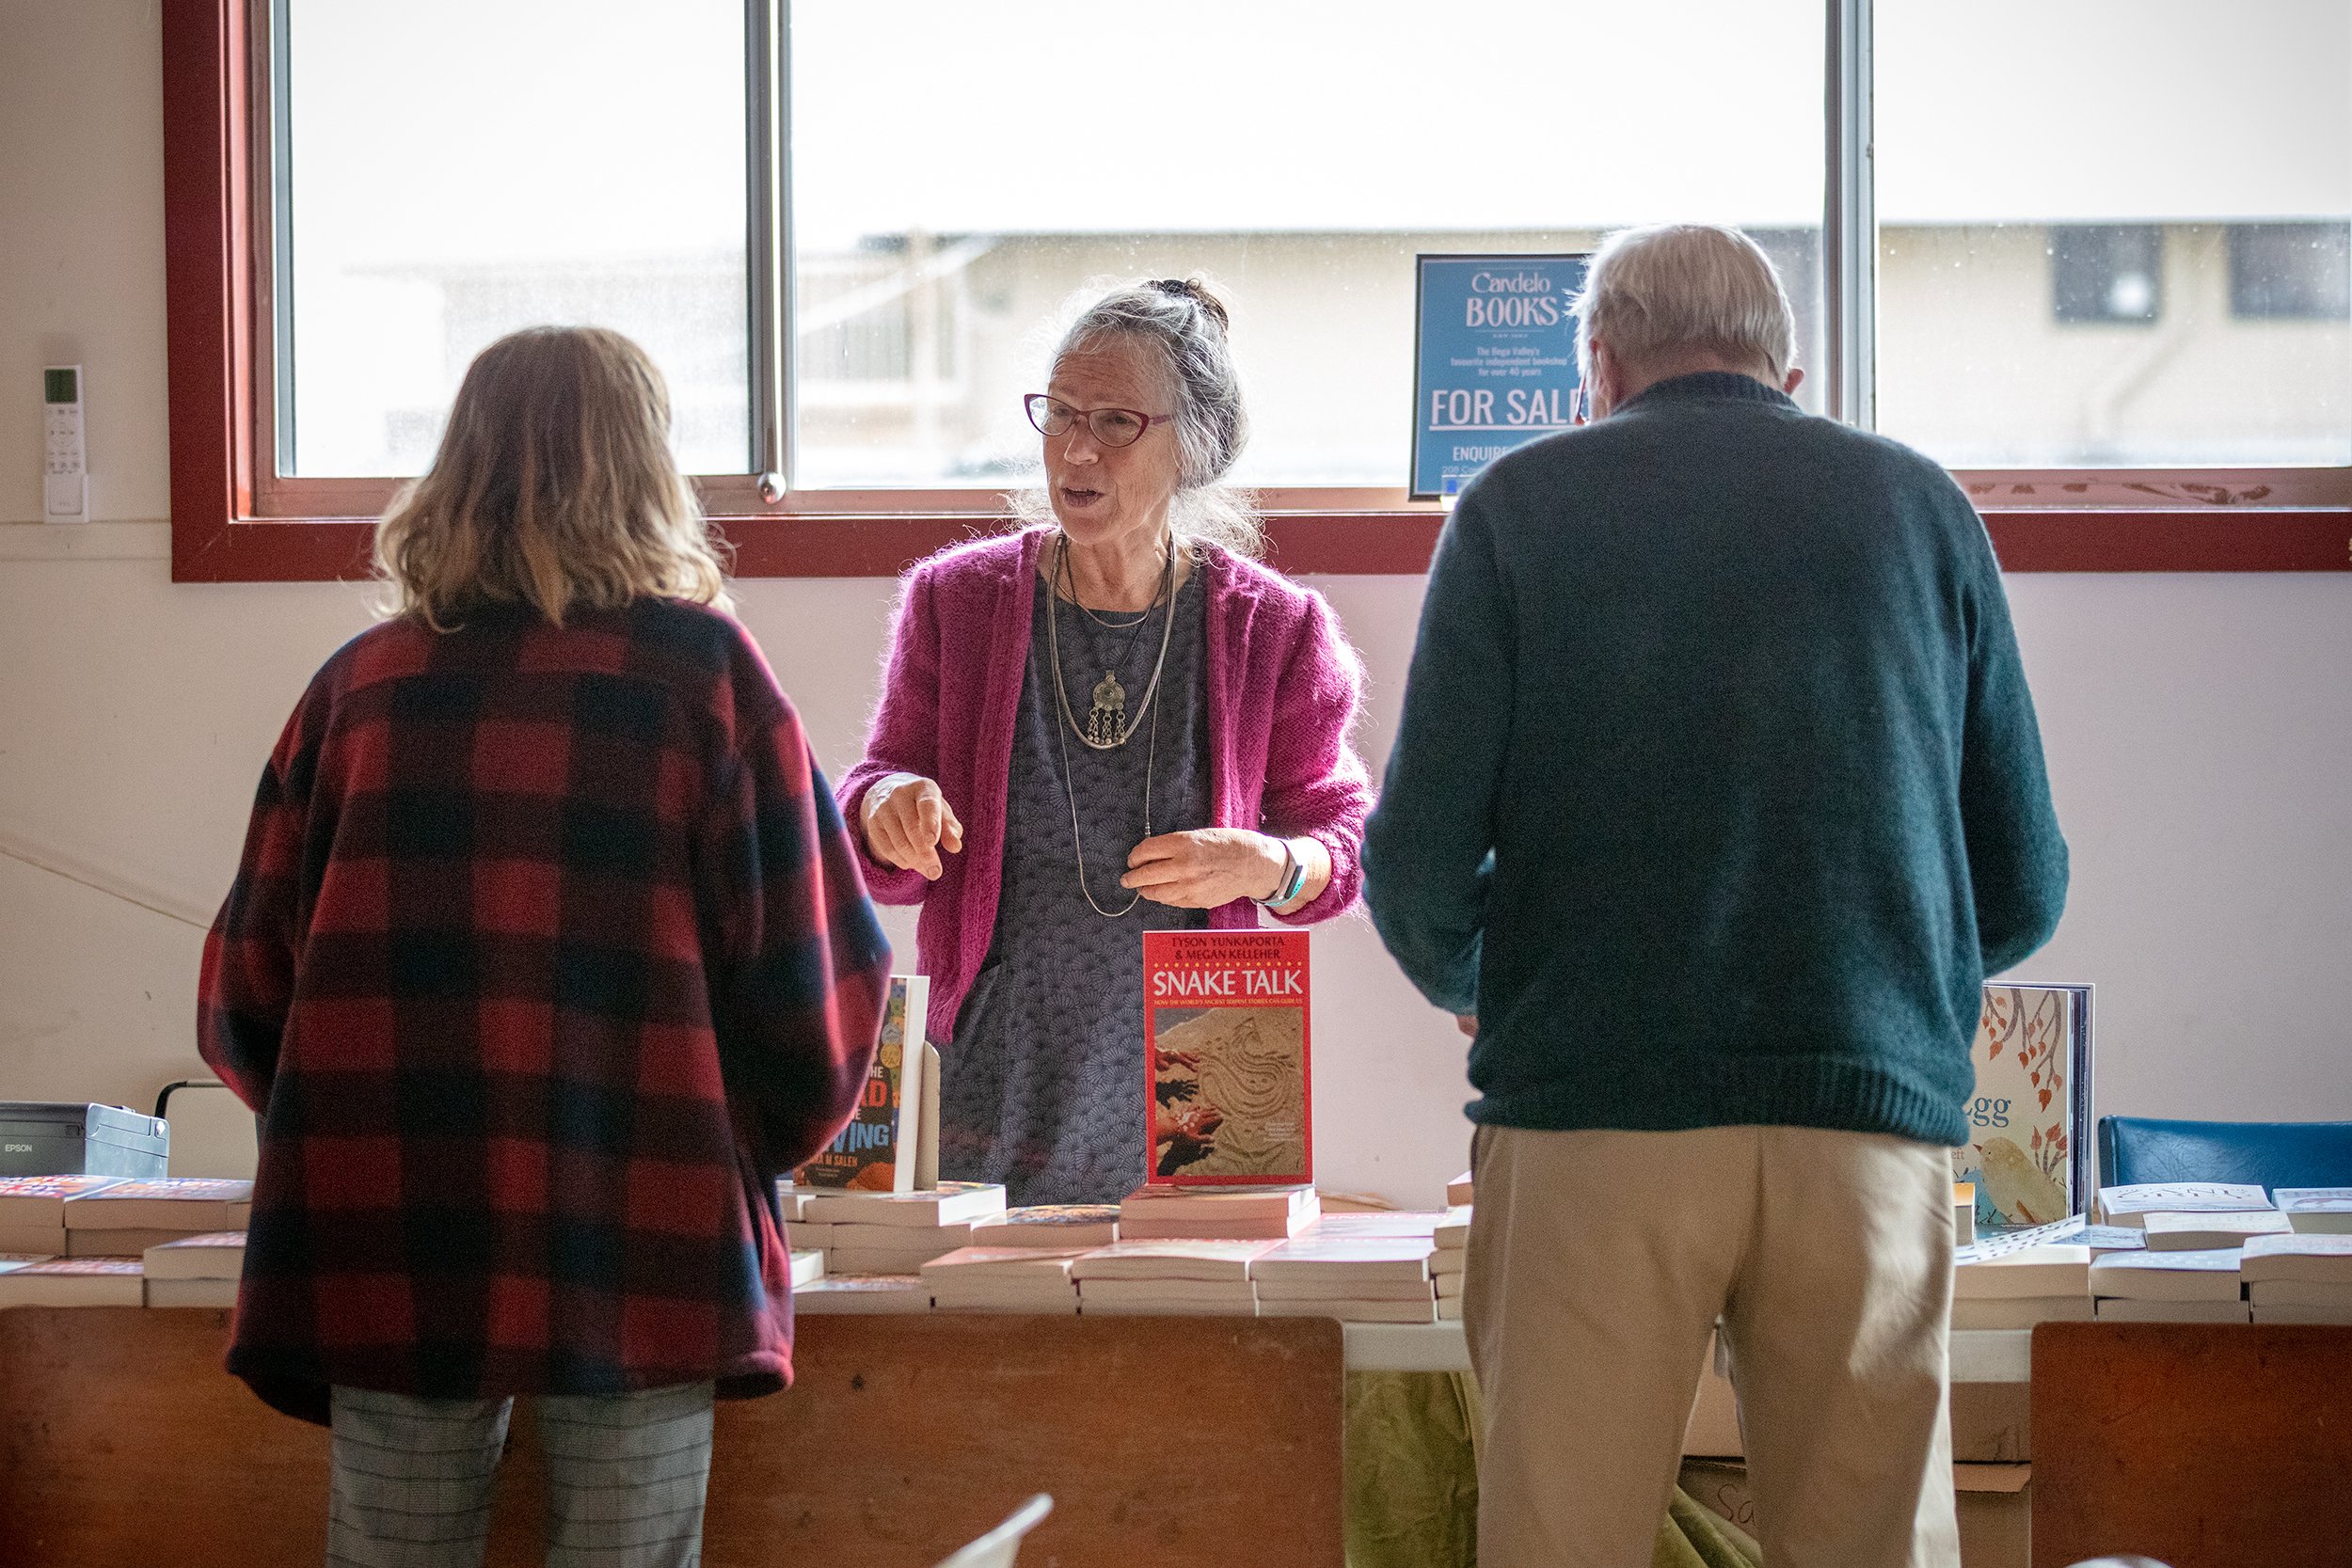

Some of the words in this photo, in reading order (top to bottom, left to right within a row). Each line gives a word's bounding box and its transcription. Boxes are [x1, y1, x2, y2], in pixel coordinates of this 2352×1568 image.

[1471, 272, 1550, 293] Candelo
[1466, 296, 1560, 327] BOOKS
[1431, 389, 1495, 425] FOR
[1172, 937, 1207, 947] TYSON
[1211, 936, 1284, 946] YUNKAPORTA
[1175, 950, 1183, 959] &
[1185, 949, 1226, 959] MEGAN
[1228, 948, 1280, 959] KELLEHER
[1152, 970, 1236, 996] SNAKE
[1242, 969, 1303, 995] TALK
[869, 1066, 884, 1079] HE
[1966, 1097, 2011, 1128] gg
[5, 1144, 33, 1152] EPSON
[833, 1121, 889, 1153] VING
